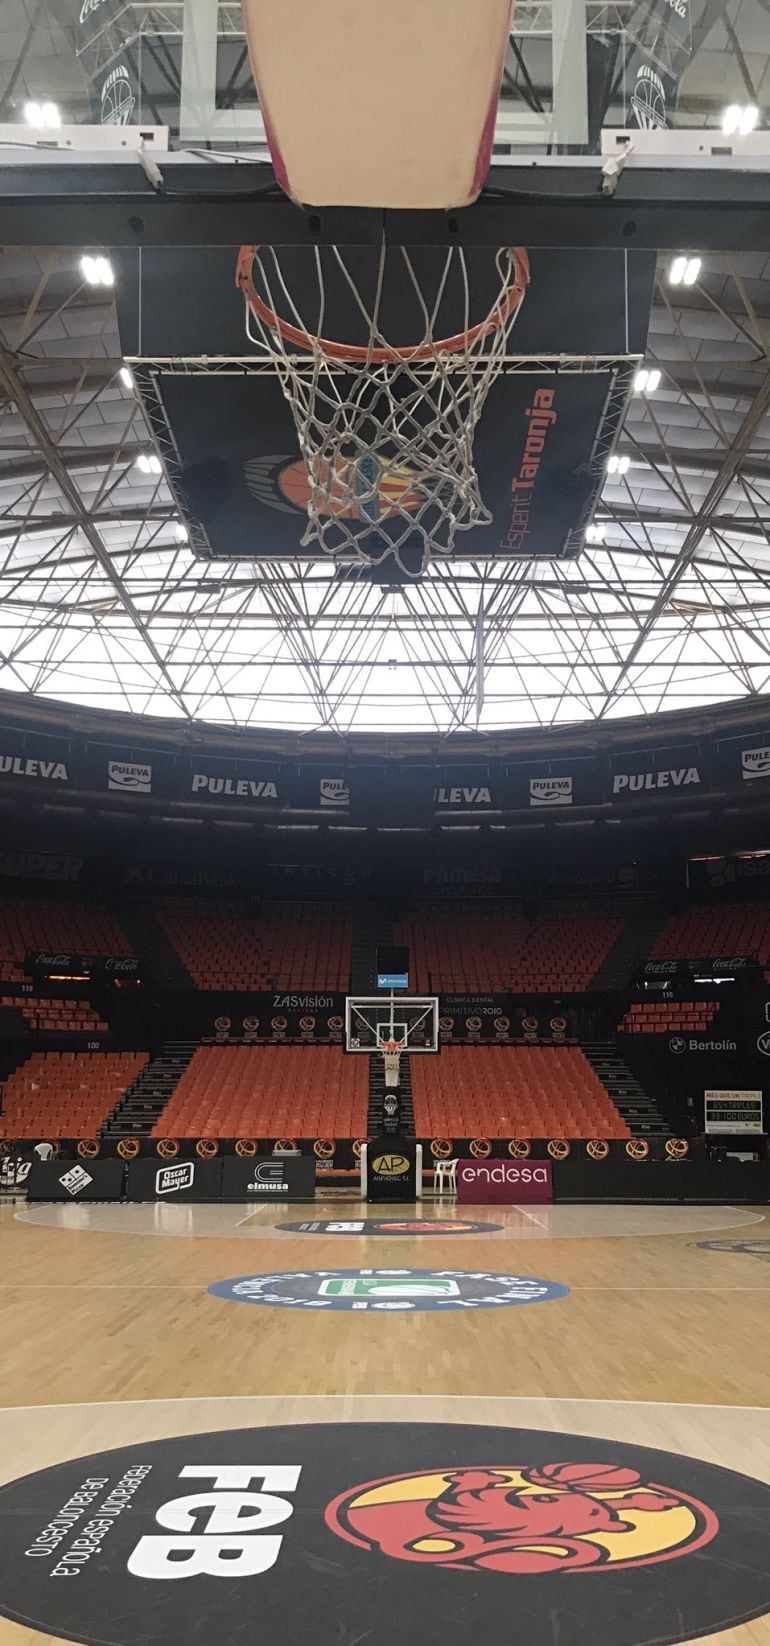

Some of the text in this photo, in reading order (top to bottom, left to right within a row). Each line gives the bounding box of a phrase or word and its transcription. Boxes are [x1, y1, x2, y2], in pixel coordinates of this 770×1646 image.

[511, 388, 557, 492] Taronja
[0, 755, 68, 780] ULEVA
[111, 764, 149, 777] PULEVA
[191, 774, 278, 798] PULEVA
[532, 781, 570, 791] PULEVA
[613, 767, 700, 794] PULEVA
[434, 787, 492, 803] LEVA
[272, 995, 334, 1008] ZASvisión
[689, 1038, 737, 1050] Bertolín
[378, 1156, 404, 1172] AP
[162, 1175, 189, 1188] Mayer
[164, 1168, 188, 1180] Oscar
[461, 1163, 548, 1184] endesa
